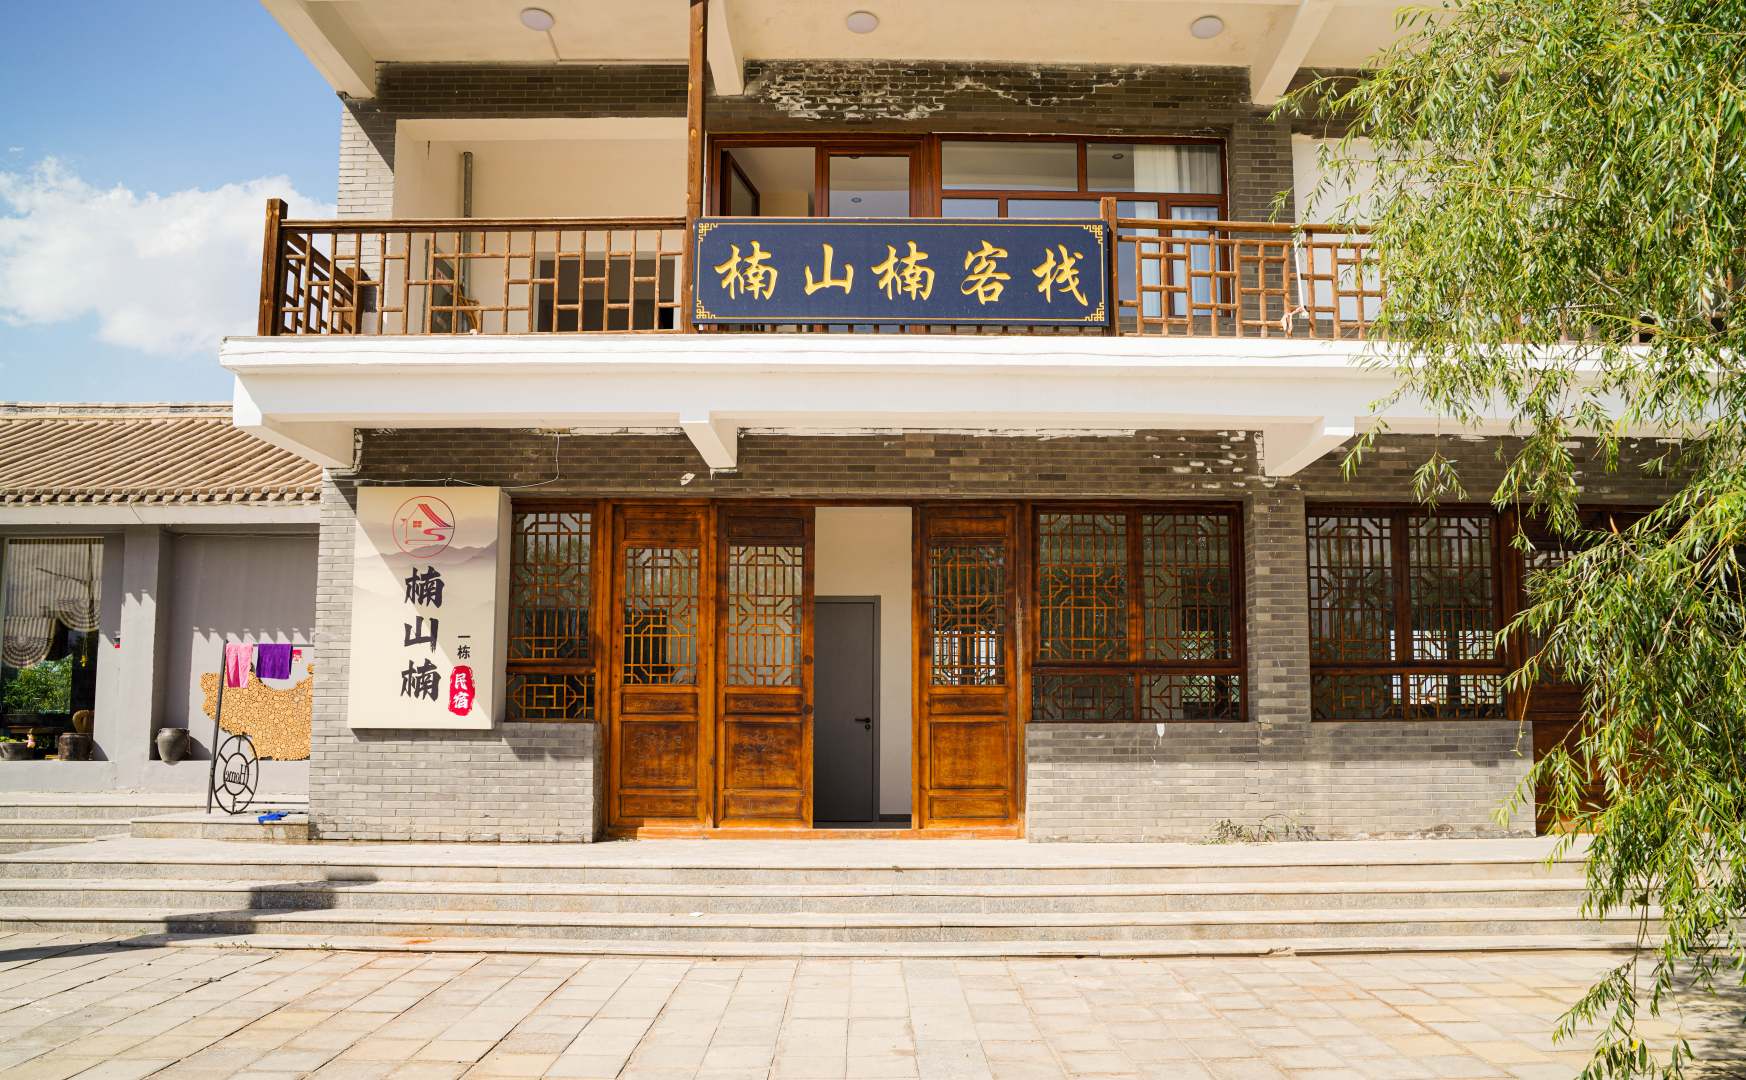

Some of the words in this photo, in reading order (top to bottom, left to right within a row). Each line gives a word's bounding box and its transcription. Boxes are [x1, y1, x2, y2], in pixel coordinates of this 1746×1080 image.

[714, 239, 1089, 306] 楠山楠客栈
[401, 565, 445, 702] 楠山楠
